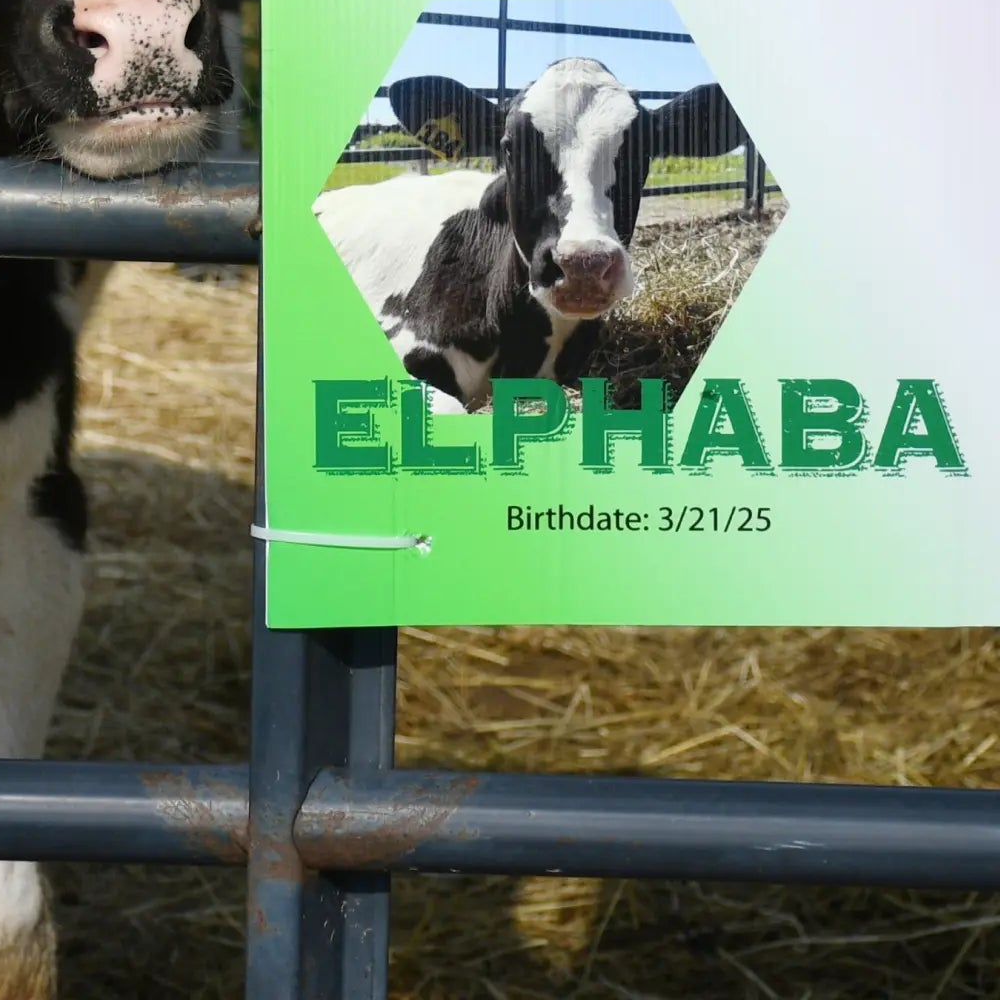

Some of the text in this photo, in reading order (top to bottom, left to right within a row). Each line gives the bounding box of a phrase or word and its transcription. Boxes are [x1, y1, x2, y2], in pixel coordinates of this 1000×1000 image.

[311, 375, 969, 480] ELPHABA
[507, 504, 771, 533] Birthdate: 3/21/25
